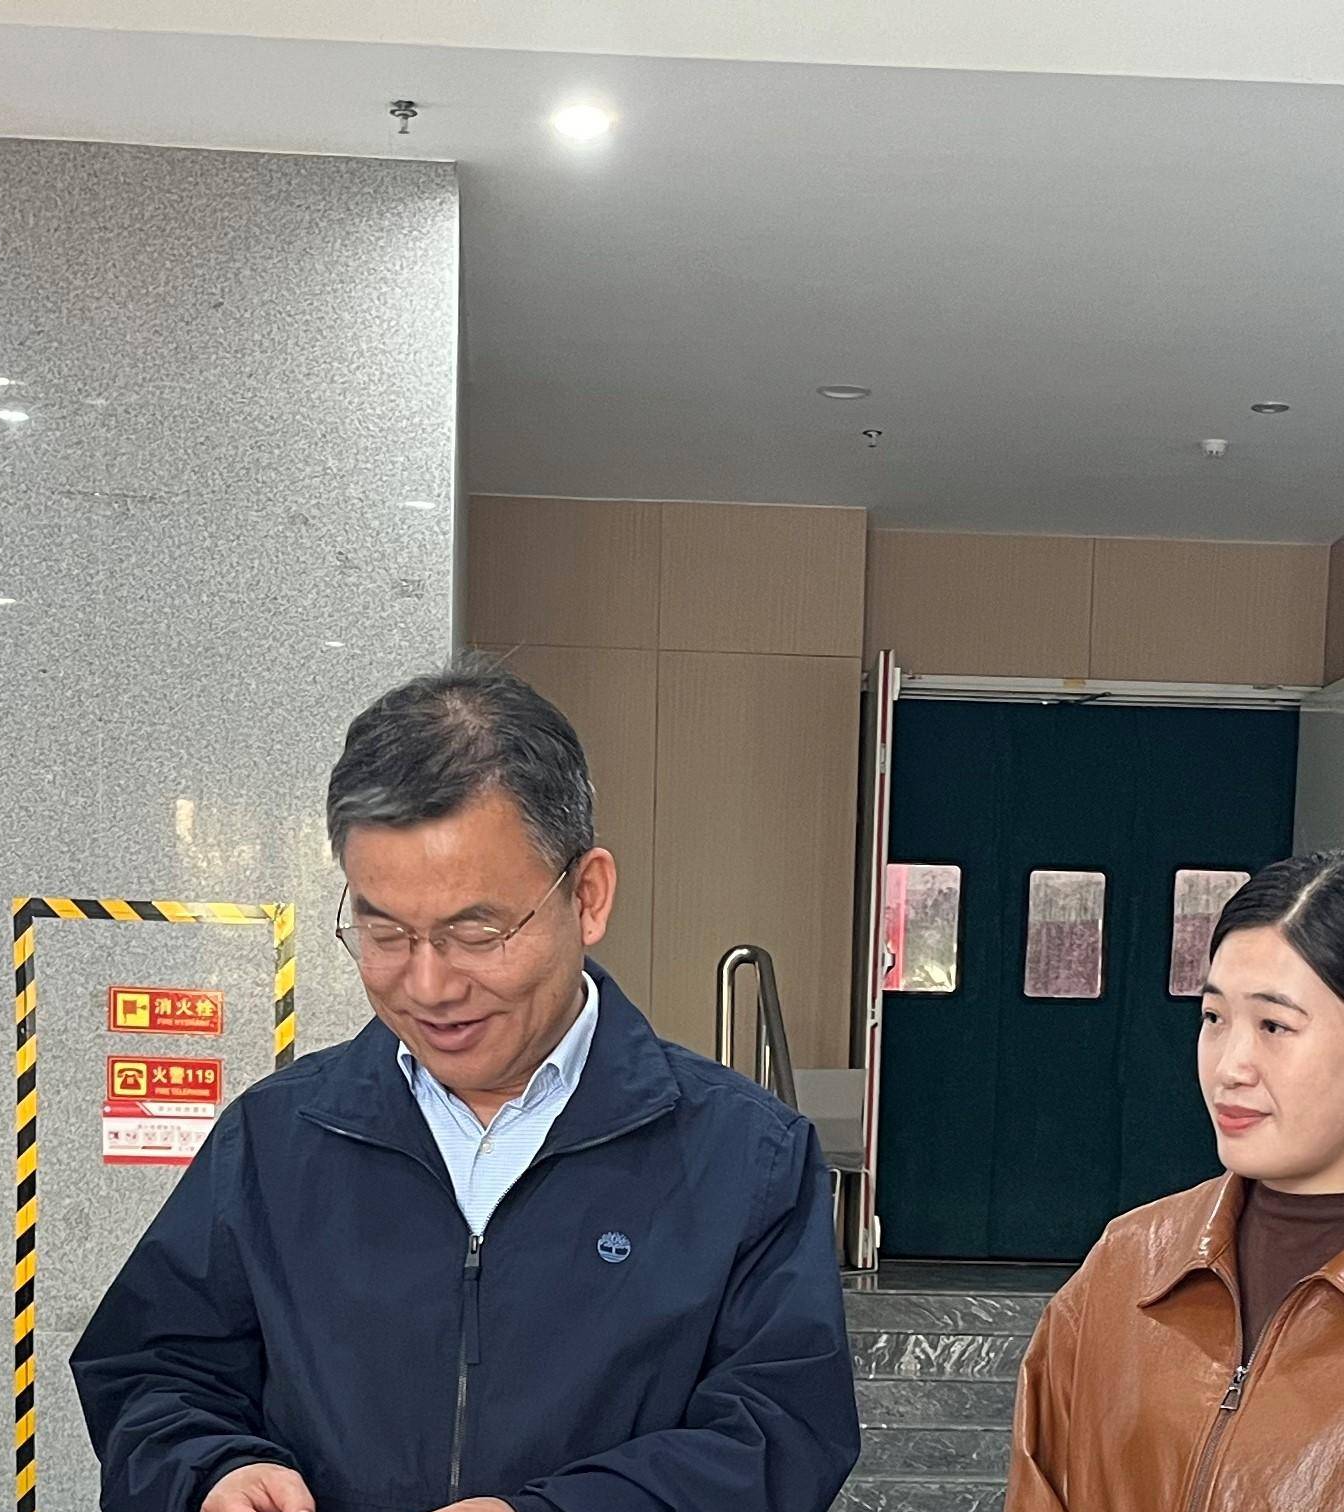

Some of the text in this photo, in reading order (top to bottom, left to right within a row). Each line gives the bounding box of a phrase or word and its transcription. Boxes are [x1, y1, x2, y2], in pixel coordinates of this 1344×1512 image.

[154, 997, 215, 1017] 消火栓
[152, 1066, 216, 1084] 火警119
